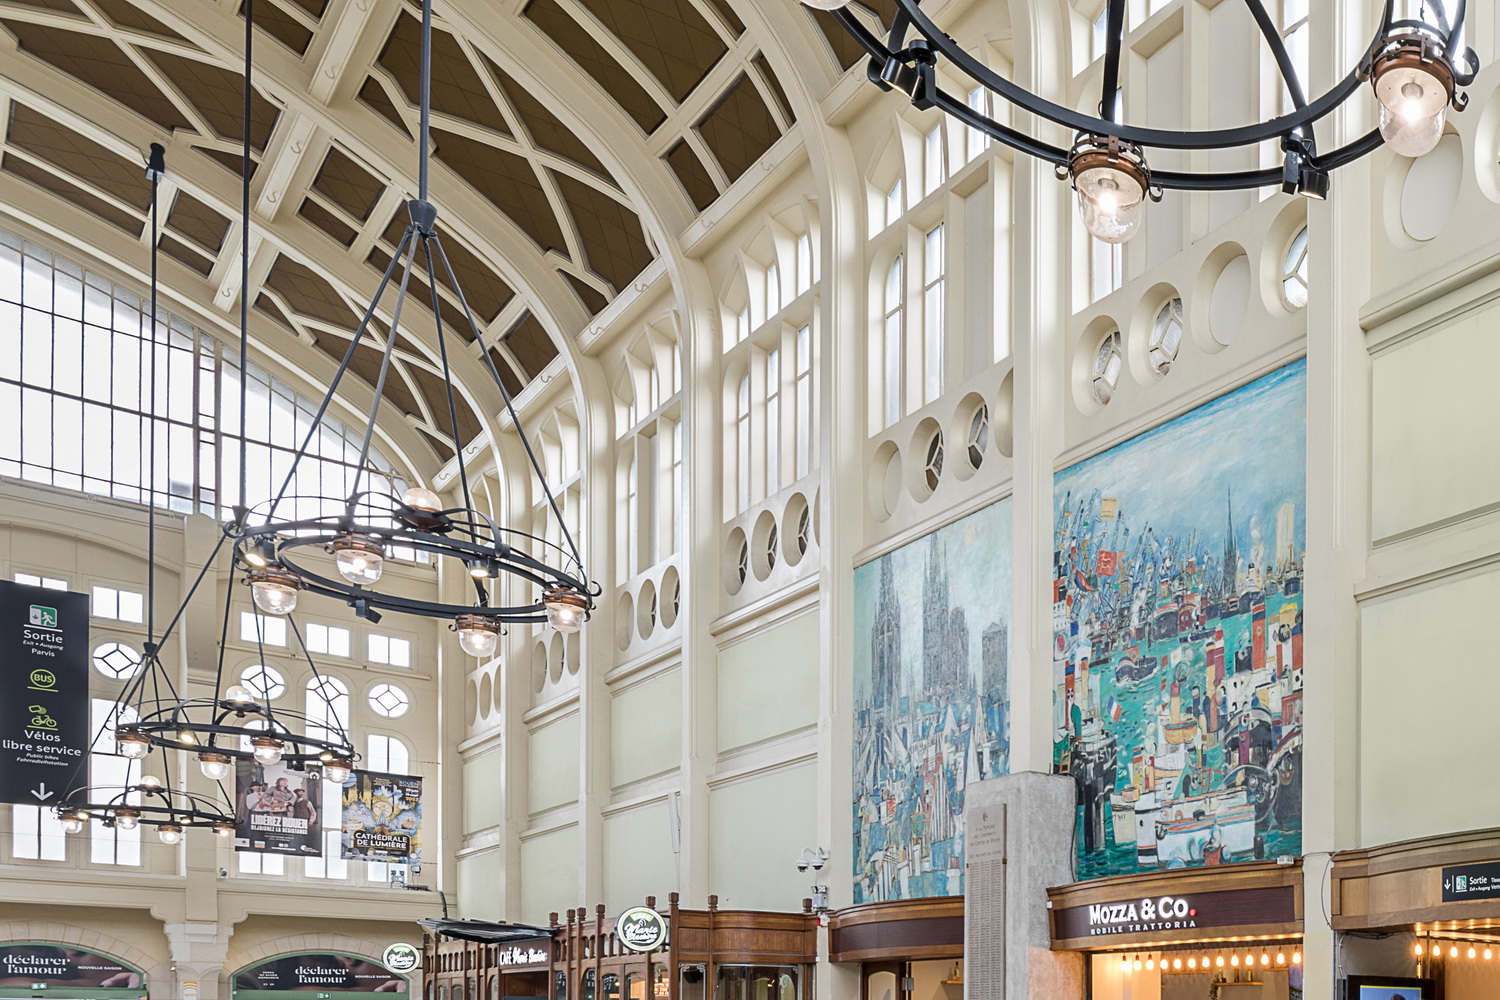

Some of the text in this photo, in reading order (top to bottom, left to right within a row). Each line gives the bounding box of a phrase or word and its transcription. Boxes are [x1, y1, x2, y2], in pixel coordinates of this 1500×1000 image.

[23, 629, 63, 644] Sortie
[39, 642, 64, 651] Ausgang
[31, 648, 55, 657] Parvis
[34, 674, 53, 683] BUS
[24, 729, 61, 742] Vélos
[2, 739, 82, 757] libre service
[356, 832, 408, 844] CATHÉDRALE
[370, 840, 406, 848] LUMIÈRE
[1469, 876, 1488, 885] Sortie
[1140, 898, 1156, 920] &
[1090, 920, 1196, 936] MOBILE TRATTORIA
[2, 954, 71, 966] déclarer
[8, 964, 67, 975] l'amour
[294, 966, 350, 976] déclarer
[298, 974, 346, 984] l'amour
